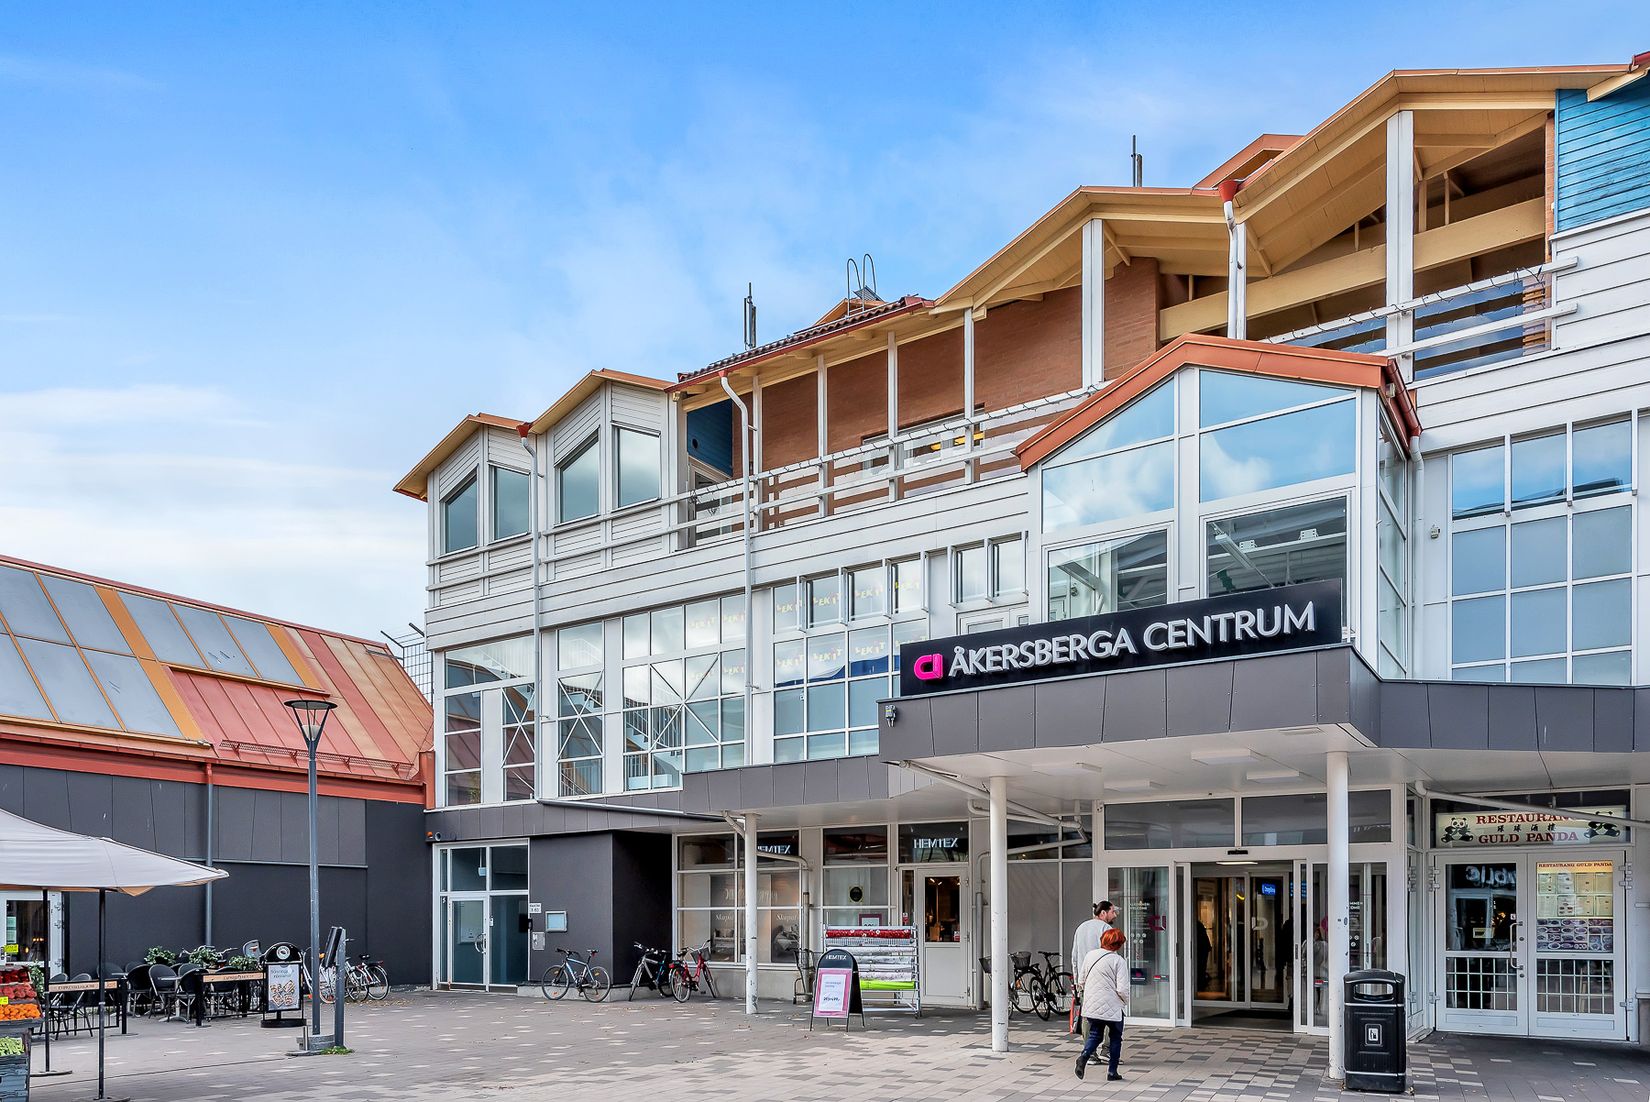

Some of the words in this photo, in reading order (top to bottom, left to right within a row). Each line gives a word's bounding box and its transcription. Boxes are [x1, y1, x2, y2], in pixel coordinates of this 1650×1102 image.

[949, 627, 1139, 677] ÅKERSBERGA
[1143, 601, 1316, 651] CENTRUM
[914, 837, 959, 849] HEMTEX
[1478, 833, 1520, 844] GULD
[1526, 831, 1579, 843] PANDA
